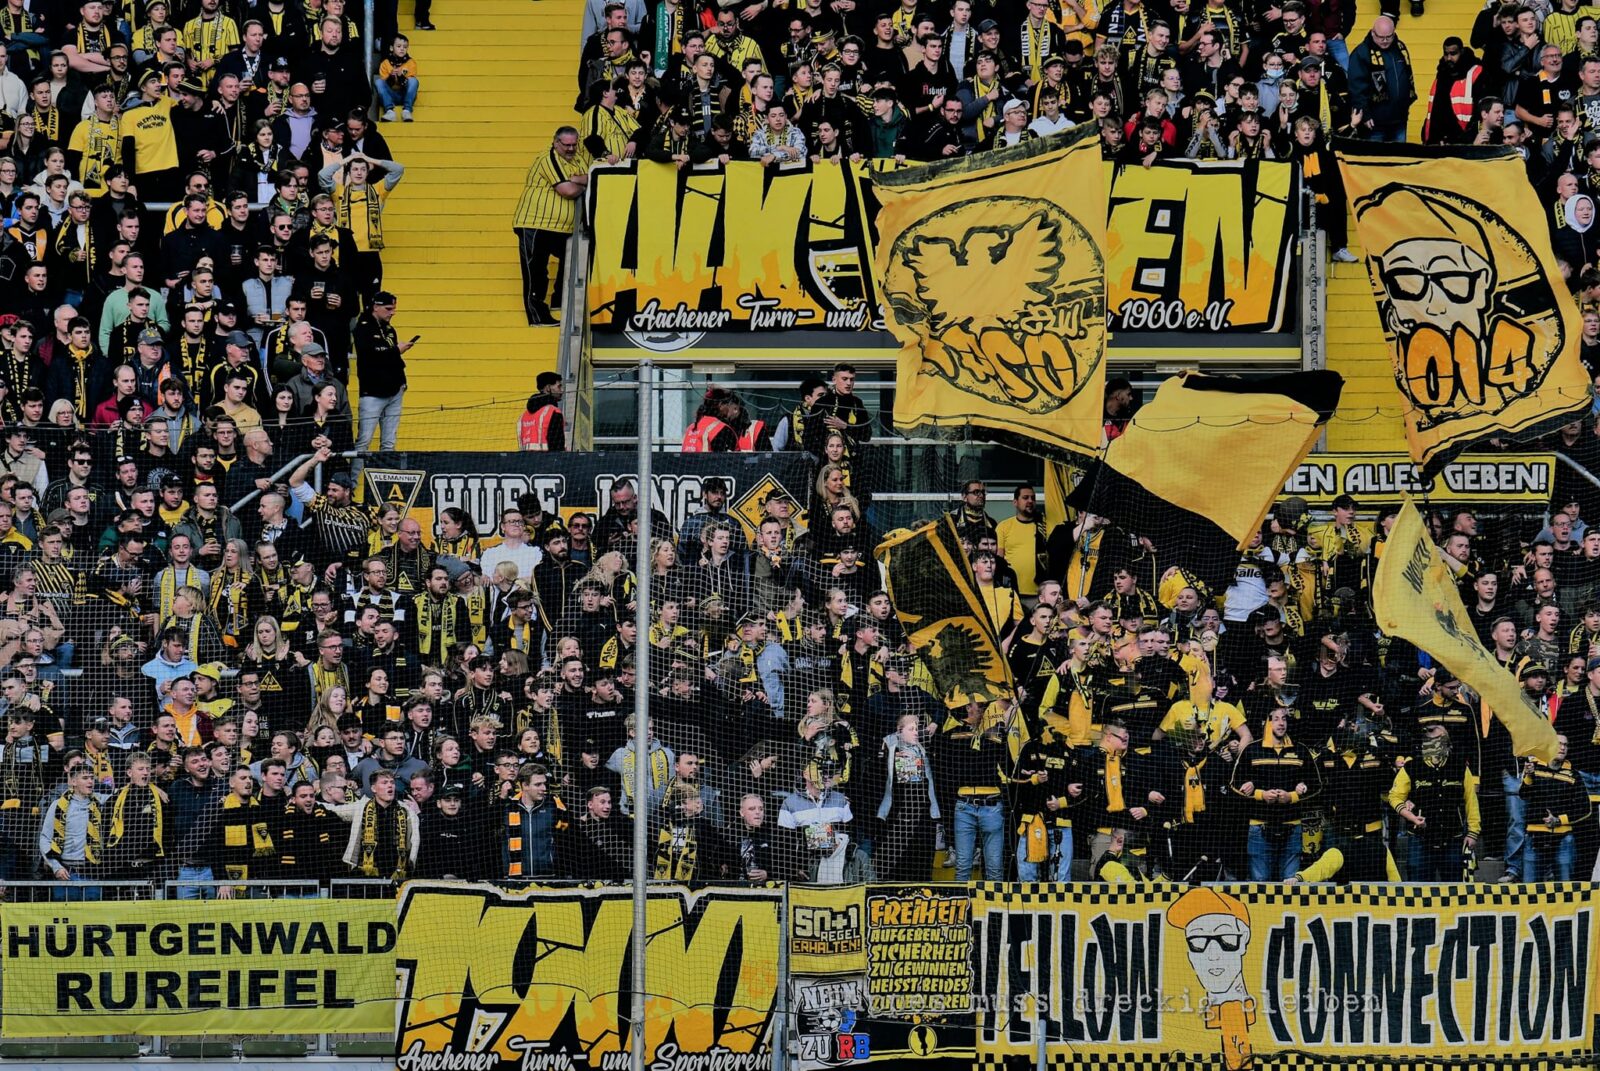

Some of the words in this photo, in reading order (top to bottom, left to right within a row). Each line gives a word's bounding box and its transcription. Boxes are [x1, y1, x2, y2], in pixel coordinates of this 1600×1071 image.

[633, 300, 730, 331] Aachener
[737, 295, 813, 331] Turn-
[826, 303, 865, 328] und
[1404, 318, 1536, 410] 014
[373, 474, 418, 482] ALEMANNIA
[1443, 464, 1548, 491] GEBEN!
[869, 898, 969, 926] FREIHEIT
[8, 917, 397, 959] HÜRTGENWALD
[792, 938, 862, 954] ERHALTEN!
[820, 929, 861, 941] REGEL
[947, 926, 968, 942] UM
[871, 943, 970, 961] SICHERHEIT
[871, 962, 890, 976] ZU
[974, 911, 1161, 1043] YELLOW
[1266, 911, 1591, 1045] CONNECTION
[56, 969, 355, 1013] RUREIFEL
[801, 982, 859, 1010] NEIN
[870, 977, 918, 993] HEISST
[398, 1041, 500, 1071] Aachener
[801, 1034, 830, 1060] ZU
[837, 1034, 870, 1059] RB
